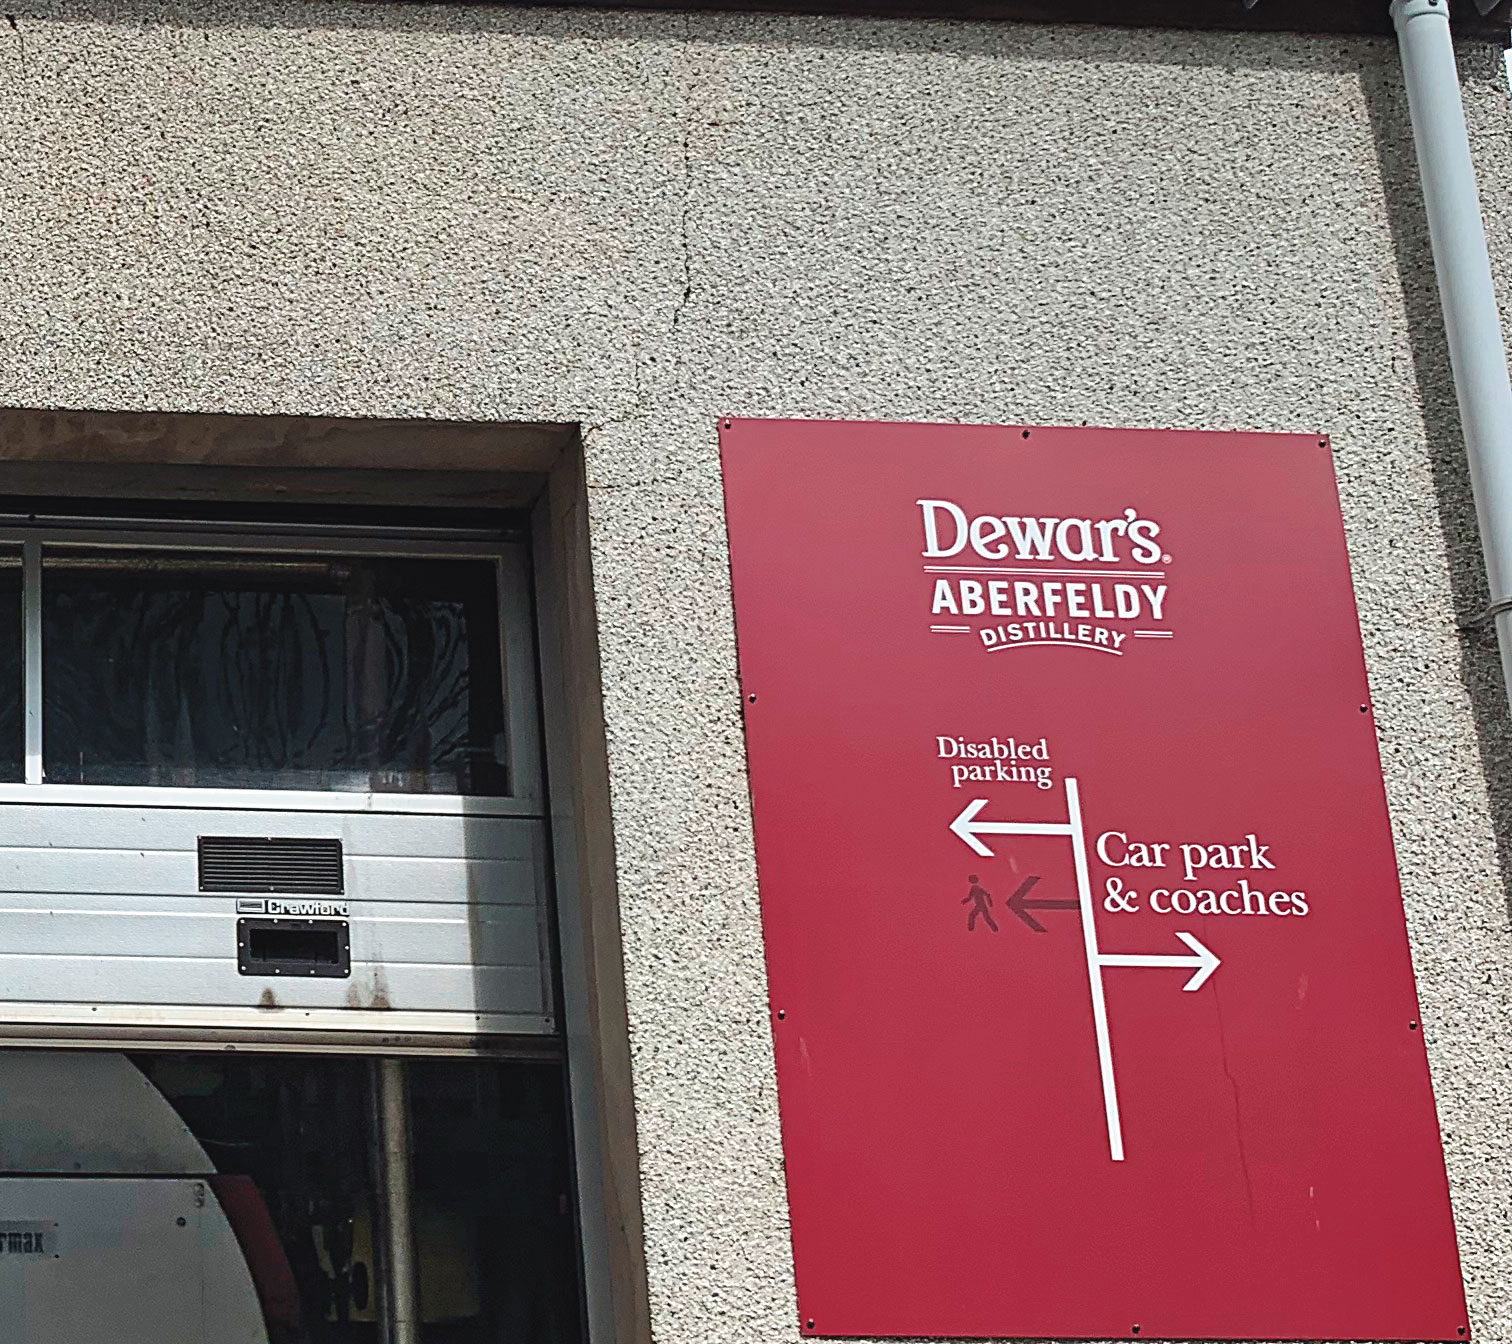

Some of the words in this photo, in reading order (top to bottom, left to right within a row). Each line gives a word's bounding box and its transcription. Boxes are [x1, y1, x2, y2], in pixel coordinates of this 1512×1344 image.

[916, 499, 1162, 564] Dewar's
[932, 579, 1167, 619] ABERFELDY
[979, 622, 1127, 649] DISTILLERY
[936, 736, 1050, 761] Disabled
[951, 761, 1053, 789] parking
[1096, 831, 1171, 868] Car
[1180, 834, 1276, 880] park
[267, 899, 349, 916] Crawford
[1103, 877, 1139, 913] &
[1150, 880, 1309, 916] coaches
